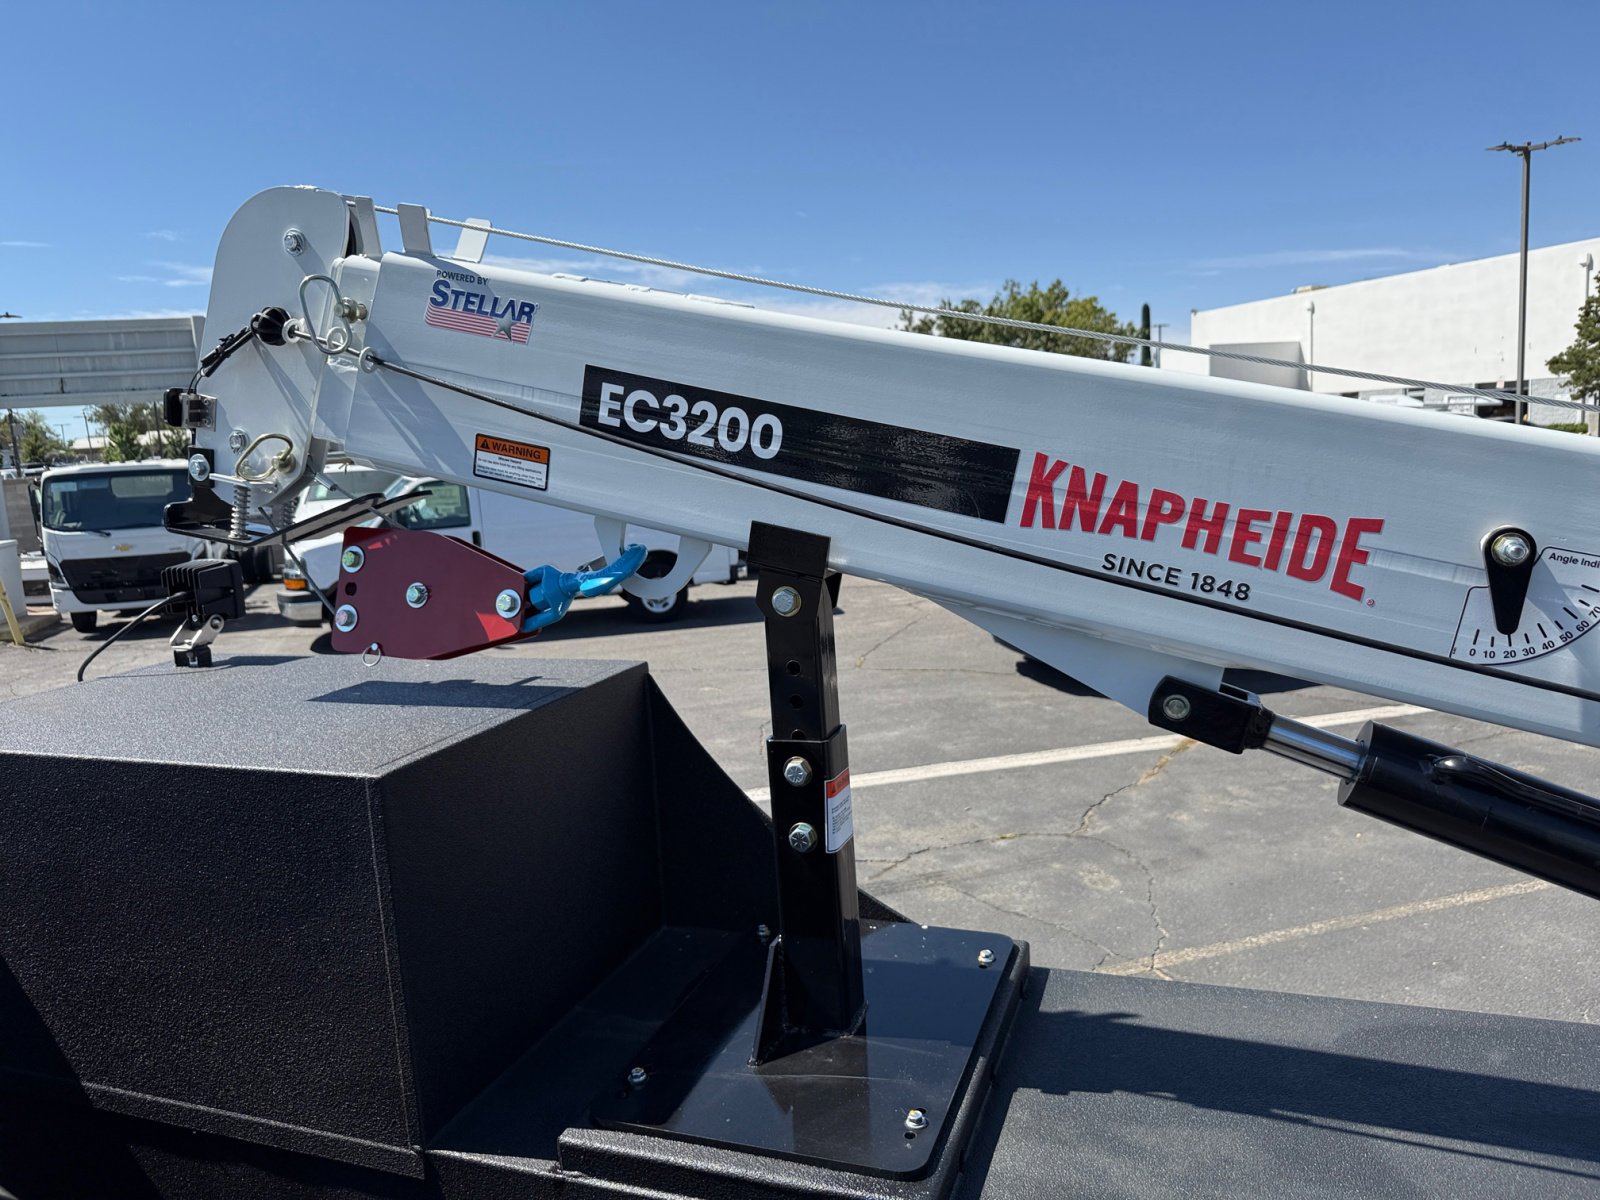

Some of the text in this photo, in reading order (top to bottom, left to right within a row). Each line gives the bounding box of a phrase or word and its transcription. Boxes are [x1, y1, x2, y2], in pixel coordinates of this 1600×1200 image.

[436, 270, 489, 286] POWERED BY
[429, 279, 536, 324] STELLAR
[598, 382, 783, 460] EC3200
[492, 441, 541, 460] WARNING
[1019, 451, 1385, 603] KNAPHEIDE
[1101, 553, 1251, 601] SINCE 1848
[1548, 552, 1600, 569] Angle Indi
[1469, 648, 1477, 657] 0
[1483, 650, 1496, 659] 10
[1503, 650, 1517, 659] 20
[1522, 646, 1536, 657] 30
[1542, 640, 1555, 651] 40
[1559, 630, 1574, 643] 50
[1576, 620, 1590, 632] 60
[1588, 606, 1600, 619] 70
